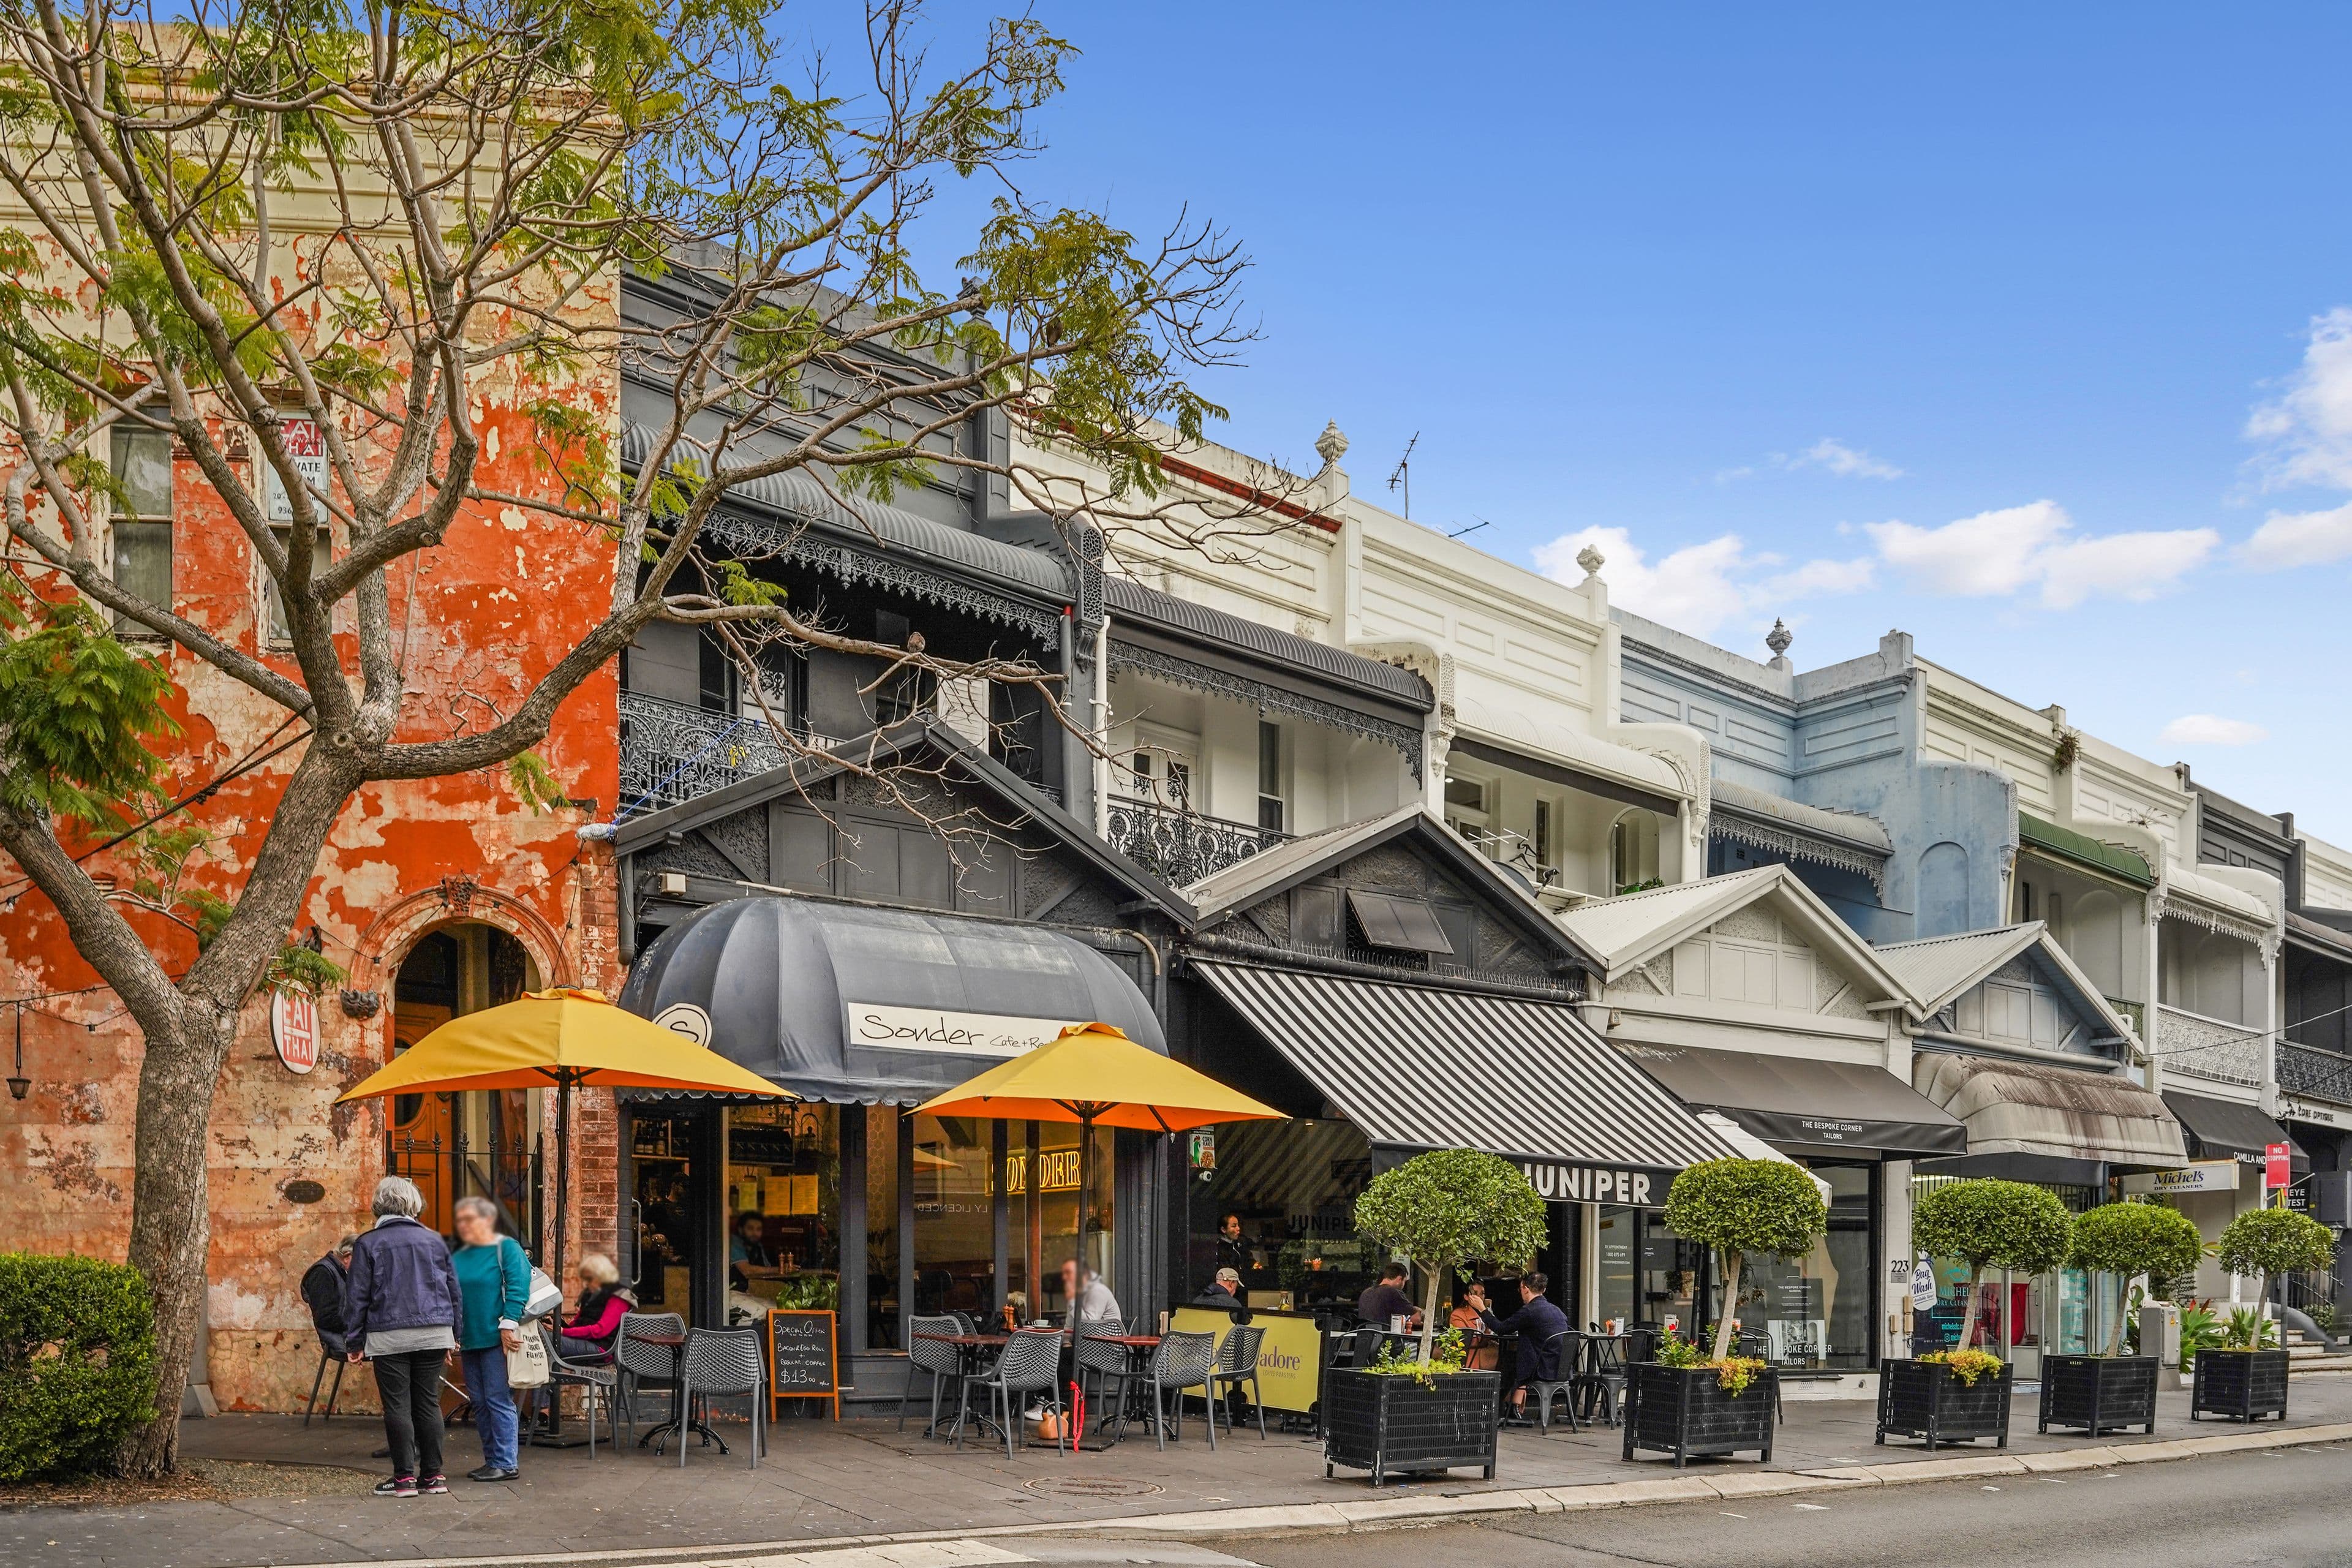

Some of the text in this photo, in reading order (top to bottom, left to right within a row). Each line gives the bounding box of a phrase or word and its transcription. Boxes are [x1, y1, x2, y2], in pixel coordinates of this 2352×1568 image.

[287, 442, 322, 455] HAI
[284, 995, 309, 1031] EAT
[860, 1015, 984, 1046] Sonder
[990, 1035, 1020, 1047] Cafe
[284, 1034, 312, 1061] THAI
[1814, 1121, 1839, 1131] BESPOKE
[1841, 1124, 1863, 1133] CORNER
[2233, 1152, 2266, 1164] CAMILLA AND
[992, 1151, 1082, 1192] ONDER
[2154, 1170, 2204, 1185] Michel's
[1525, 1163, 1651, 1204] JUNIPER
[1287, 1215, 1352, 1231] JUNIPE
[1891, 1260, 1909, 1273] 223
[1915, 1268, 1931, 1281] Bag
[1912, 1279, 1932, 1294] Wash
[1940, 1287, 1969, 1297] MICHEL
[1804, 1344, 1832, 1353] CORER
[1259, 1346, 1300, 1371] adore
